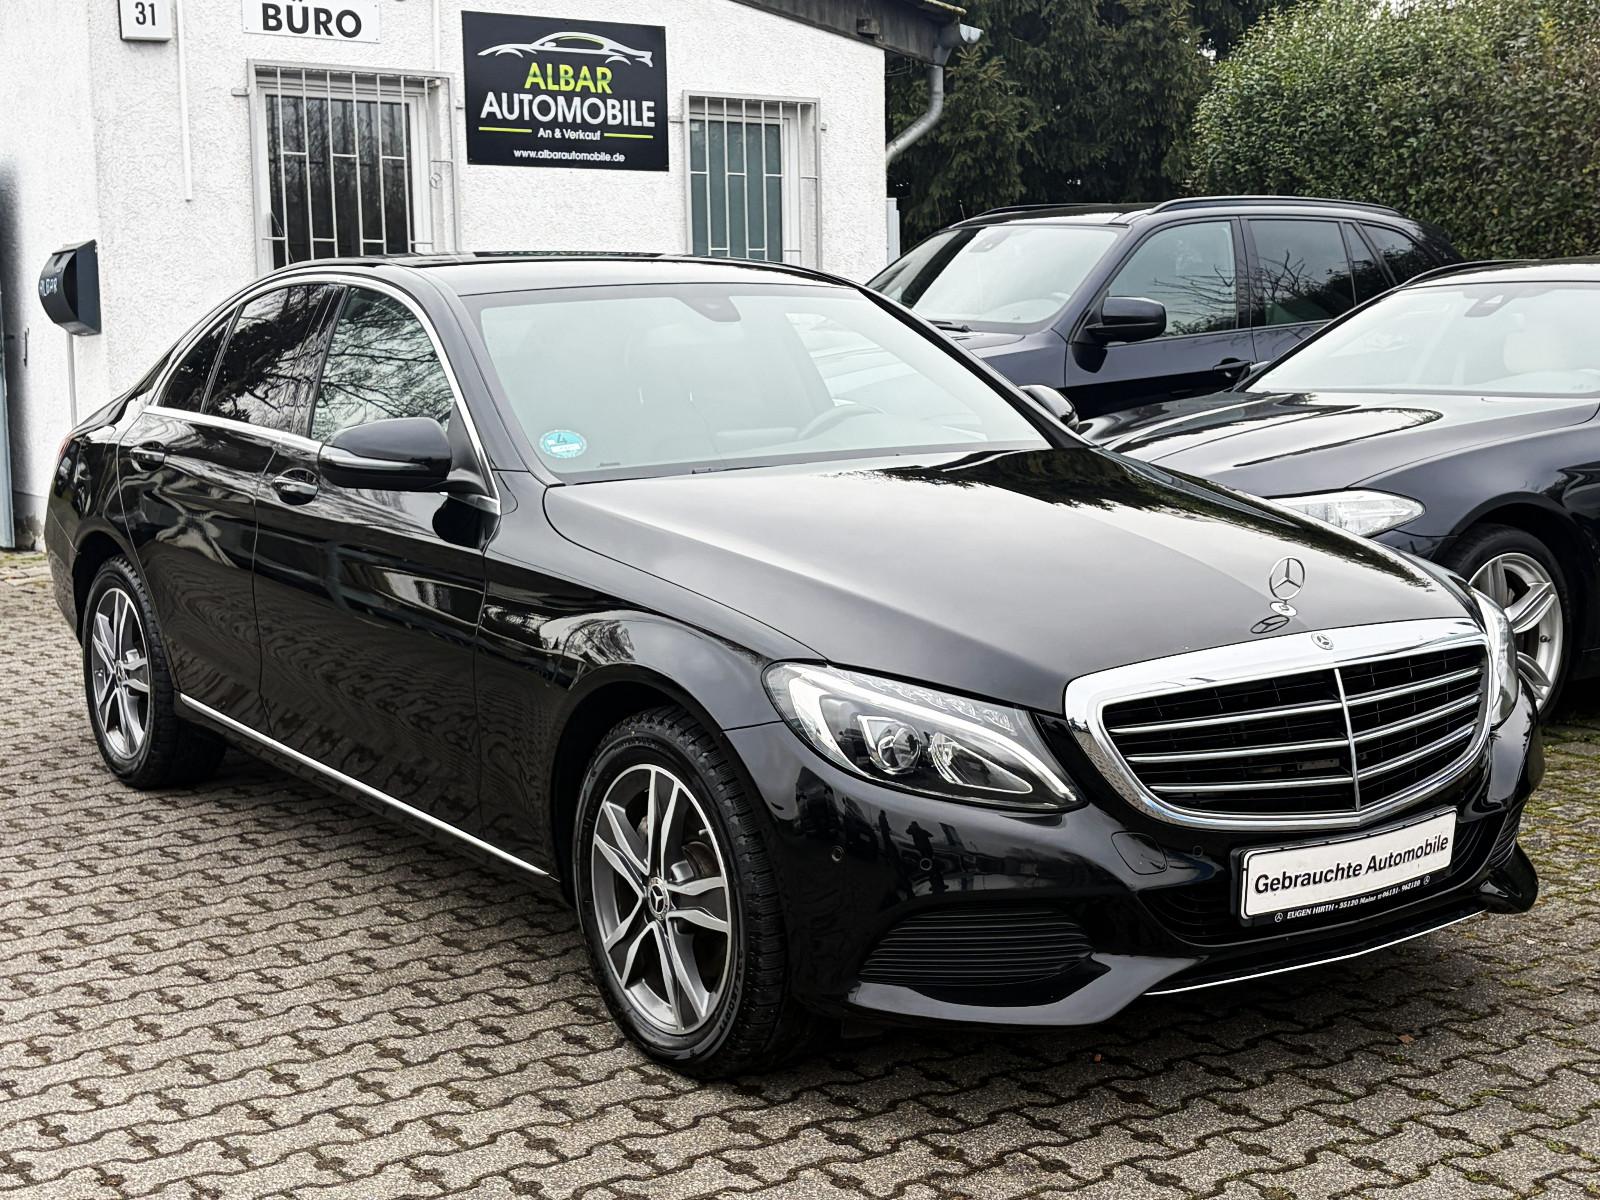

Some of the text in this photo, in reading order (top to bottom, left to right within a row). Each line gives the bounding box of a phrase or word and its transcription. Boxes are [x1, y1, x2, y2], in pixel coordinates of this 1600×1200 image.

[135, 2, 157, 26] 31
[262, 0, 362, 38] BÜRO
[524, 62, 613, 94] ALBAR
[480, 91, 655, 127] AUTOMOBILE
[538, 128, 601, 141] An & Verkauf
[513, 149, 625, 162] www.albarautomobile.de
[1254, 834, 1449, 894] Gebrauchte Automobile
[1286, 908, 1312, 919] EUGEN
[1312, 903, 1335, 915] HIRTH
